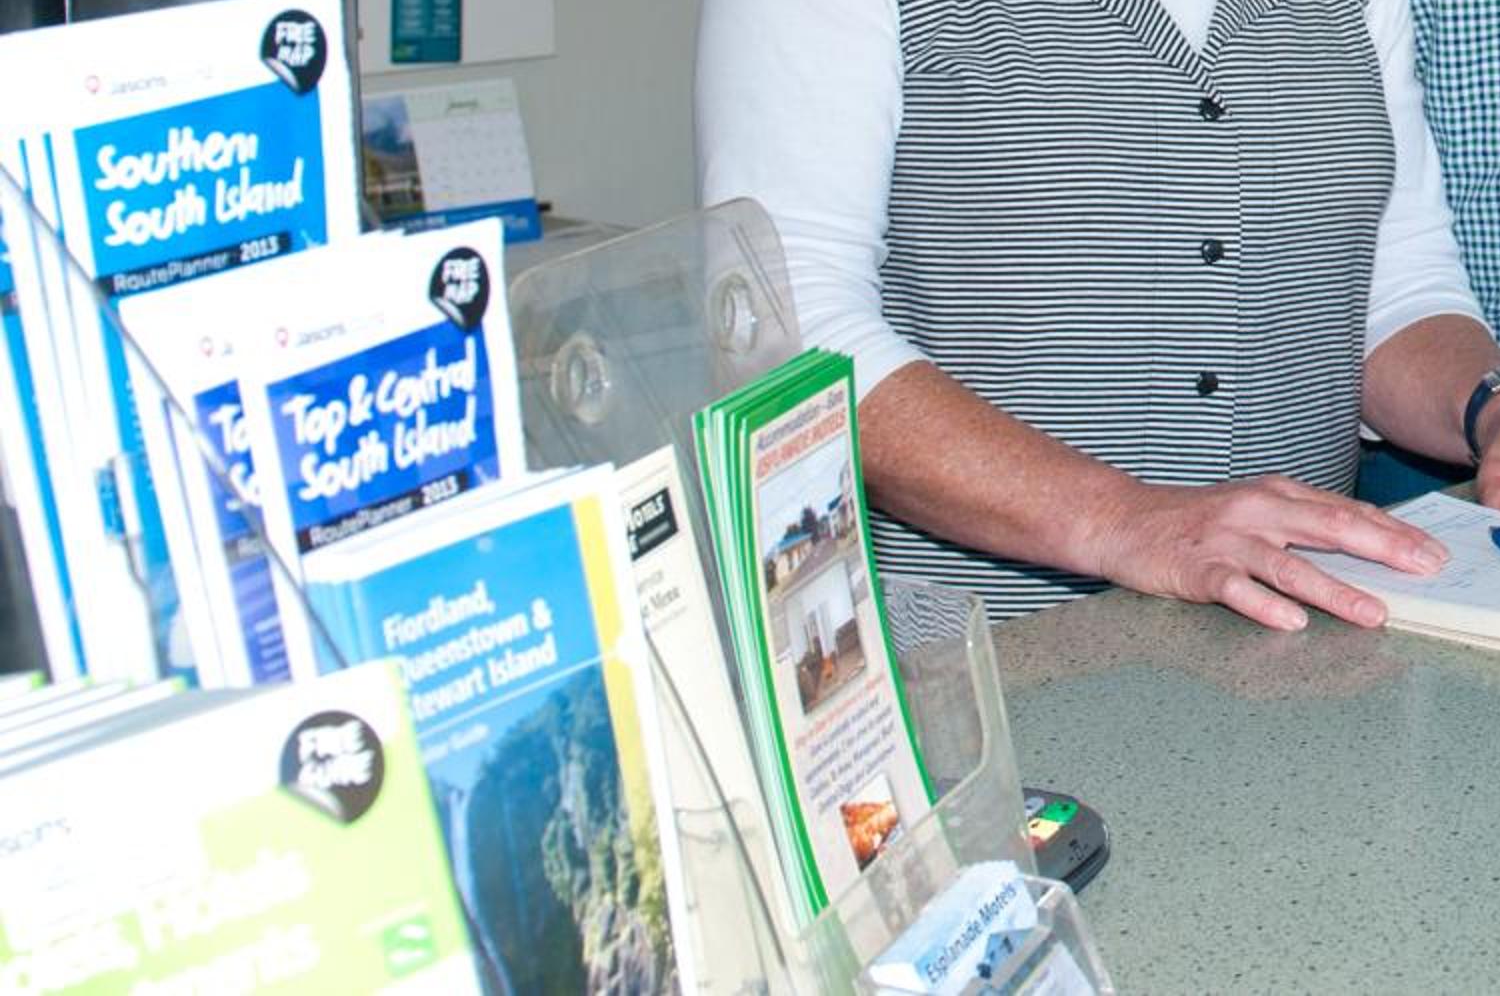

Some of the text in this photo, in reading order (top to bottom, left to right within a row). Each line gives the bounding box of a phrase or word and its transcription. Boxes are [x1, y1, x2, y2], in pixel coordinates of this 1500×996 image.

[275, 20, 315, 45] FREE
[277, 41, 315, 67] MAP
[95, 127, 259, 191] Southern
[104, 157, 306, 246] South Island
[113, 234, 280, 293] RoutePlanner 2013
[442, 256, 480, 282] FREE
[444, 278, 479, 304] MAP
[281, 337, 477, 447] Top & Central
[299, 397, 477, 502] South Island
[310, 475, 458, 546] RoutePlanner 2013
[383, 580, 496, 648] Fiordland,
[531, 597, 552, 629] &
[489, 635, 558, 689] Island
[924, 880, 1019, 986] Esplanade Motels
